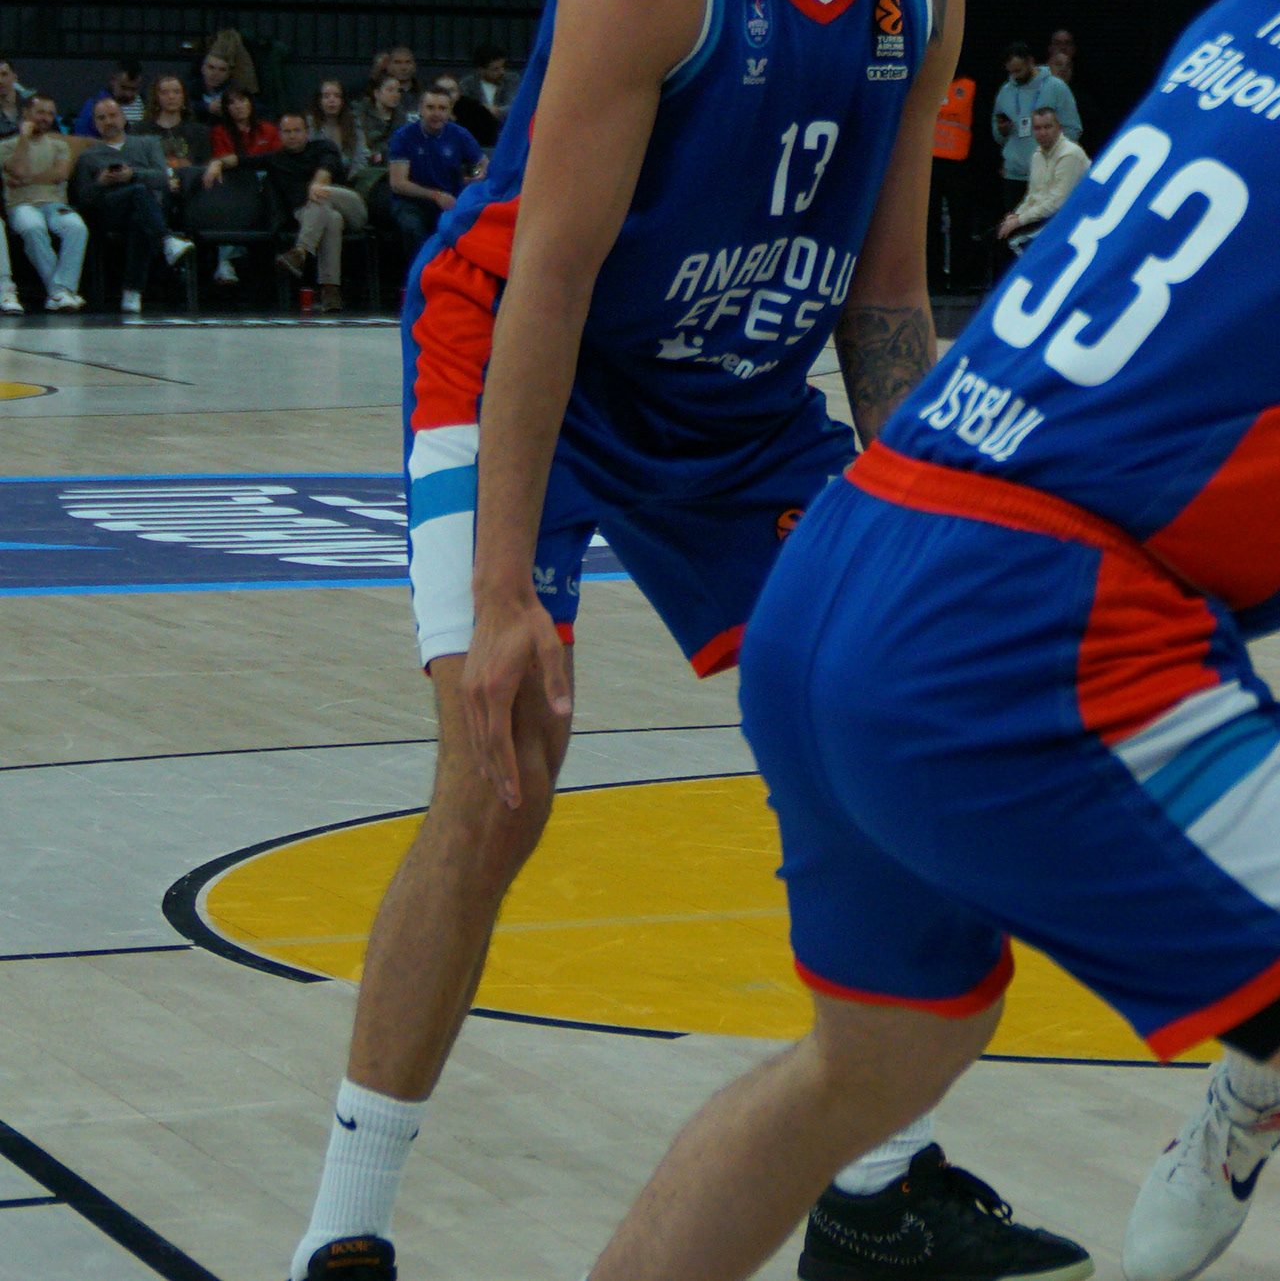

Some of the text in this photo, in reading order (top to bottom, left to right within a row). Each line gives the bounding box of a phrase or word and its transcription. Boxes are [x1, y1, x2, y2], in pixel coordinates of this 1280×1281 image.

[769, 119, 840, 216] 13
[664, 235, 857, 307] ANADOLU
[991, 123, 1250, 388] 33
[673, 287, 826, 347] EFES
